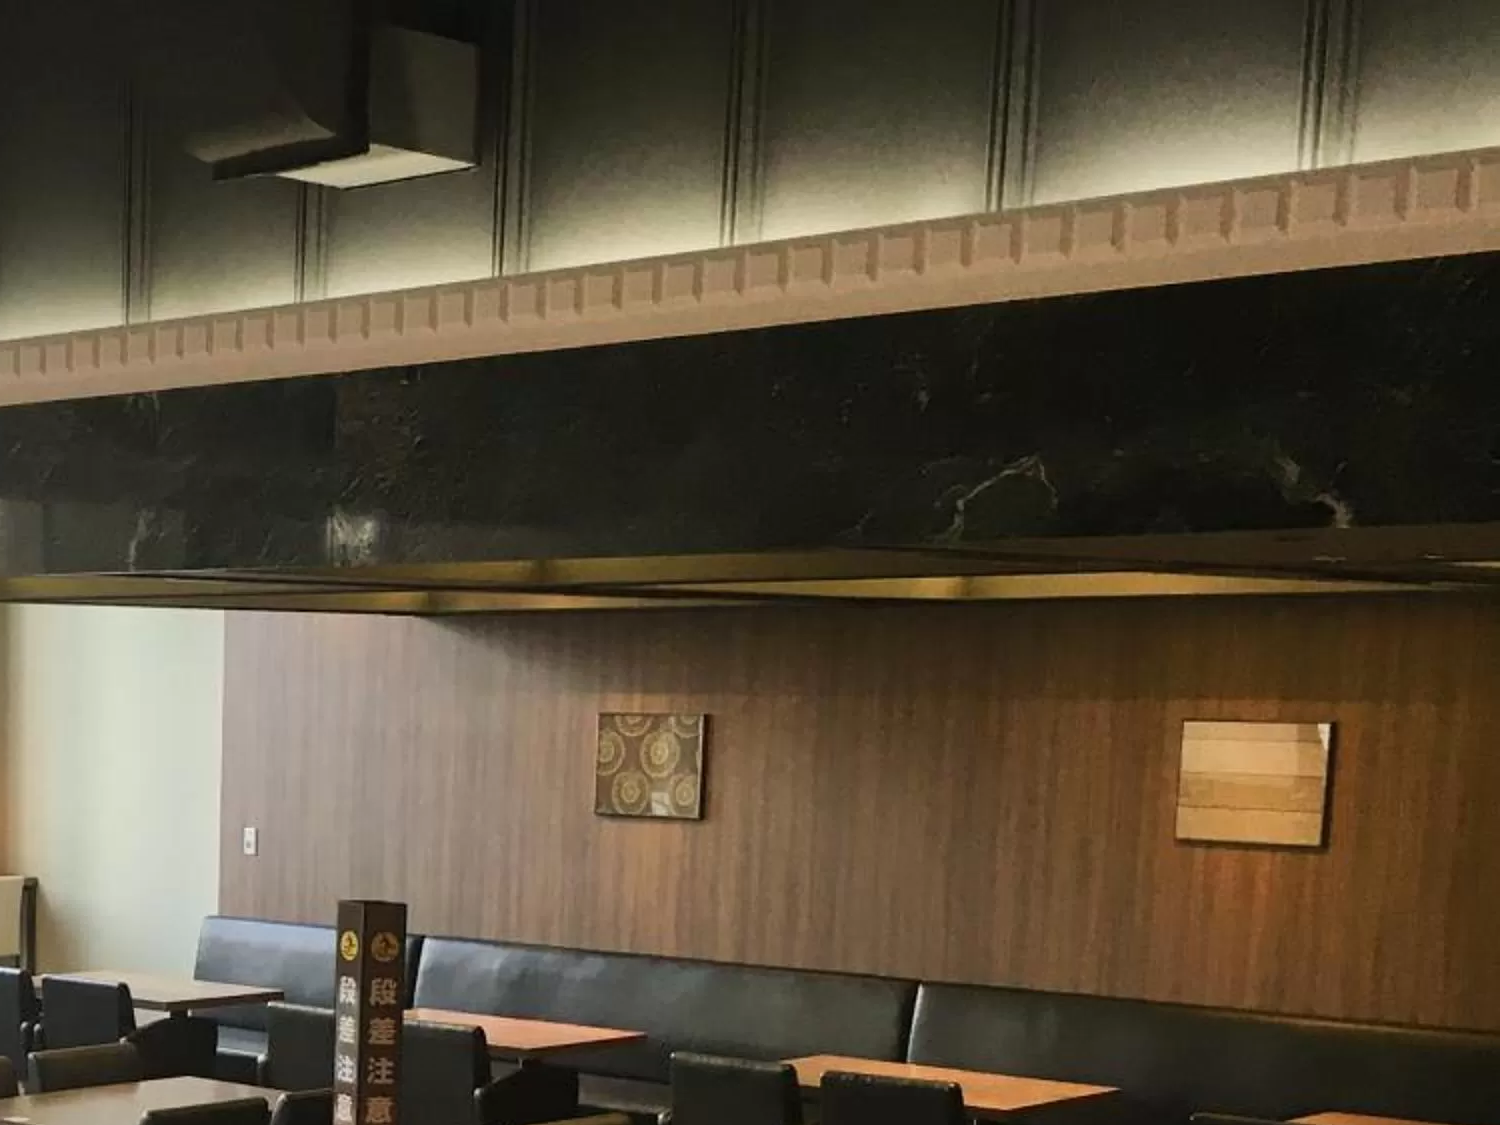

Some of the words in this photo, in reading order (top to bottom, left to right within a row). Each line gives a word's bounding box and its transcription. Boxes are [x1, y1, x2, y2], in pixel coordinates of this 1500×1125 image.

[336, 975, 358, 1123] 段差注意
[365, 977, 398, 1124] 段差注意
